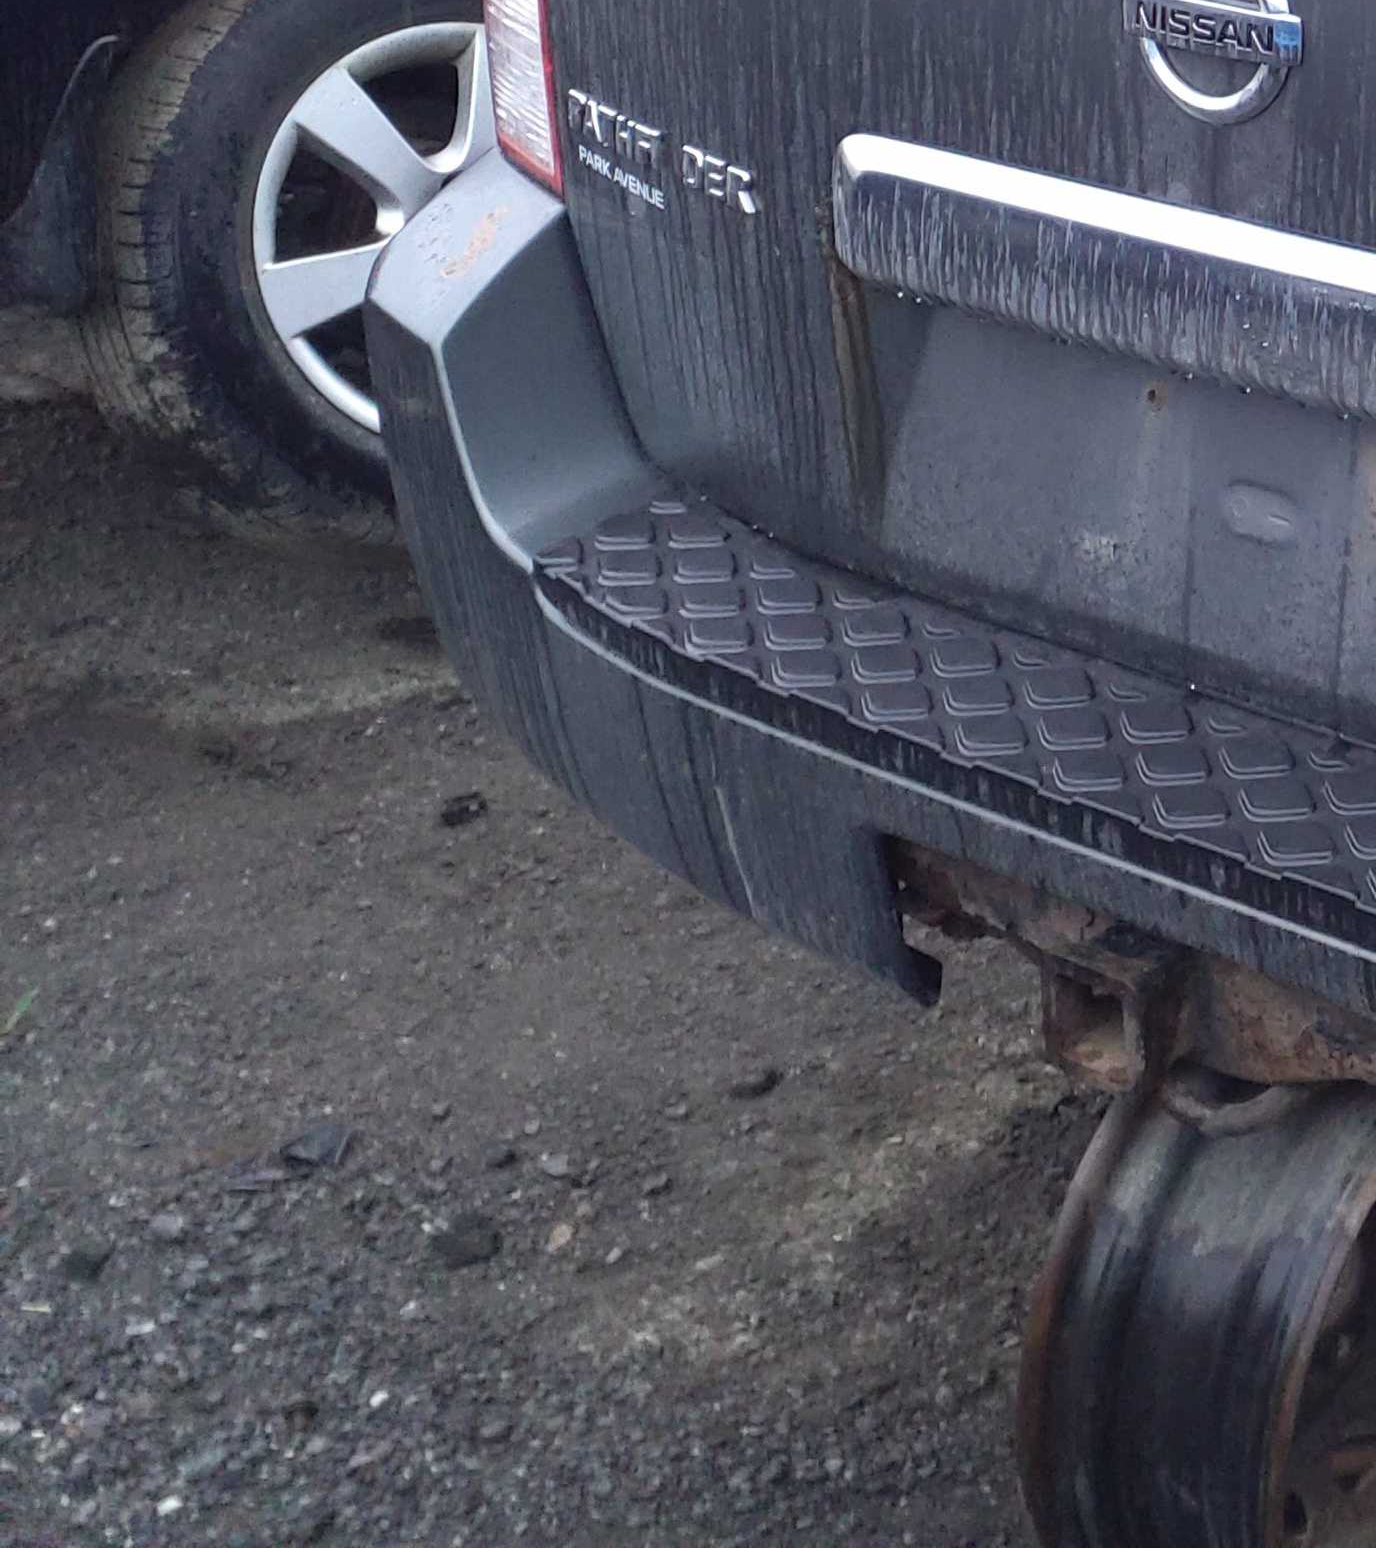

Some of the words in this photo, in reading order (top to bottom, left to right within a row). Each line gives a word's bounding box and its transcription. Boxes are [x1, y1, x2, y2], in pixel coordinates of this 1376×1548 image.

[1135, 0, 1275, 57] NISSAN
[578, 144, 613, 181] PARK
[613, 166, 666, 211] AVENUE
